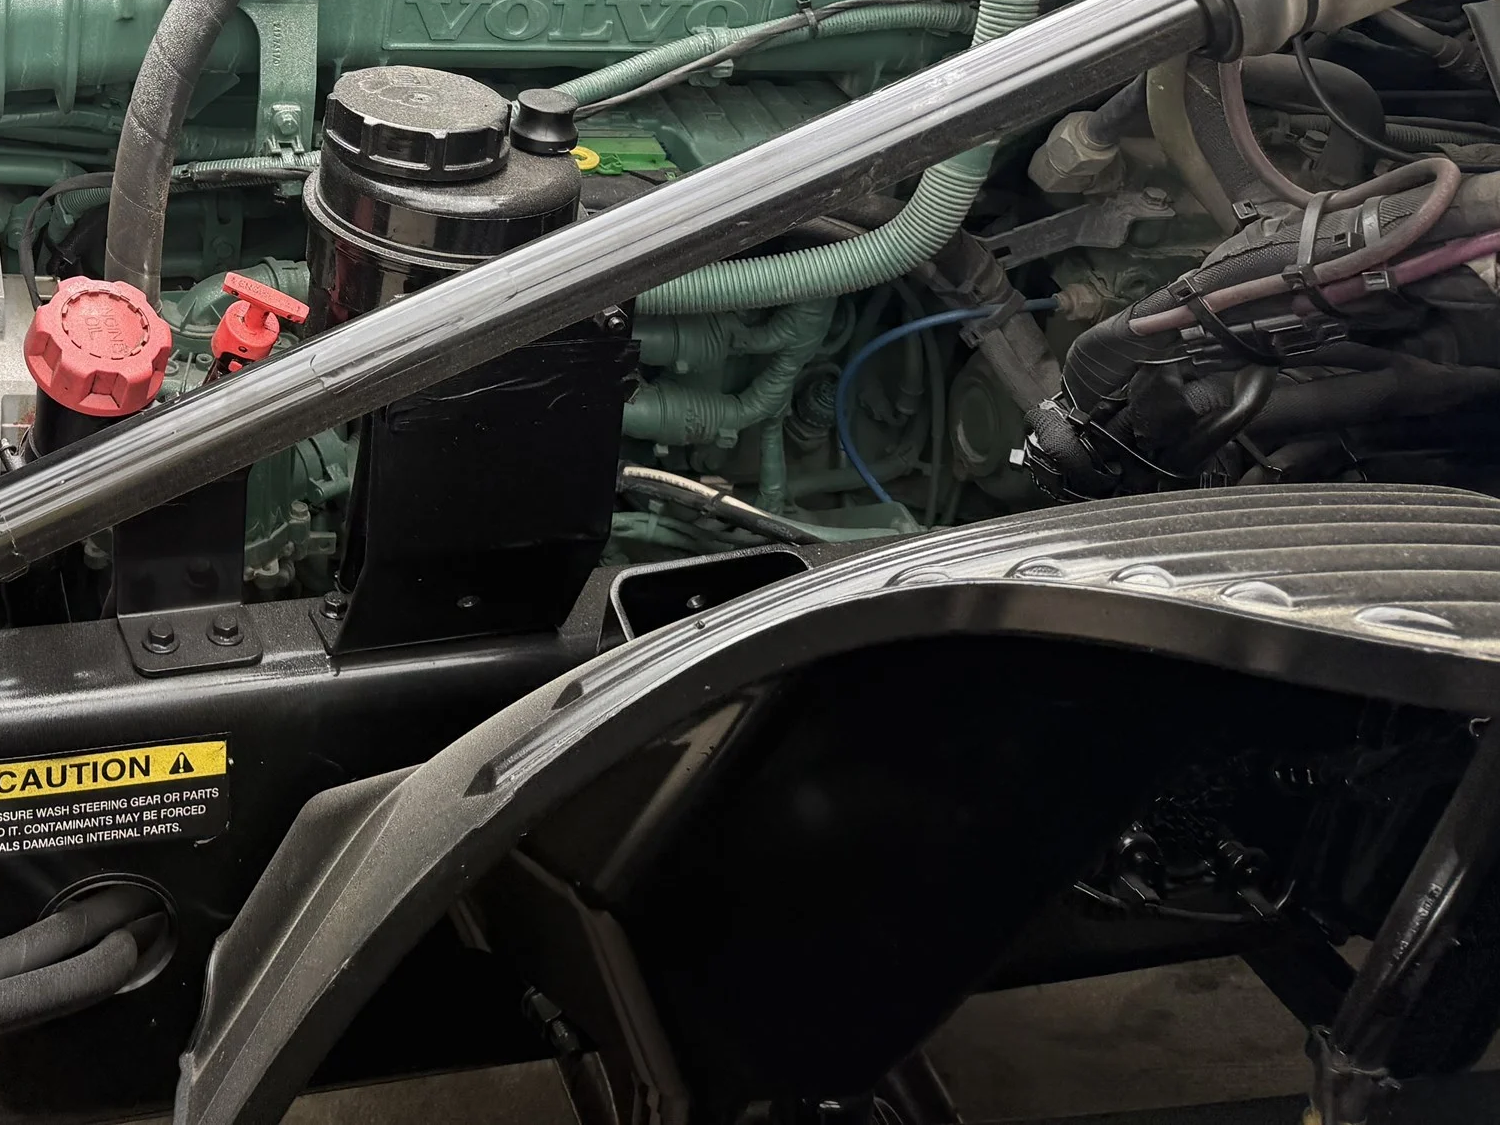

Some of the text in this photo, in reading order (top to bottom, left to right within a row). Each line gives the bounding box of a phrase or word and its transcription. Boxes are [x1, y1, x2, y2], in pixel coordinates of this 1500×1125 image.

[35, 805, 70, 818] WASH
[72, 798, 128, 814] STEERING
[130, 794, 161, 807] GEAR
[163, 792, 180, 804] OR
[182, 787, 219, 801] PARTS
[8, 826, 21, 837] IT.
[24, 816, 113, 835] CONTAMINANTS
[115, 812, 141, 825] MAY
[143, 809, 158, 821] BE
[160, 804, 207, 818] FORCED
[23, 834, 84, 850] DAMAGING
[86, 828, 141, 843] INTERNAL
[143, 822, 182, 836] PARTS.
